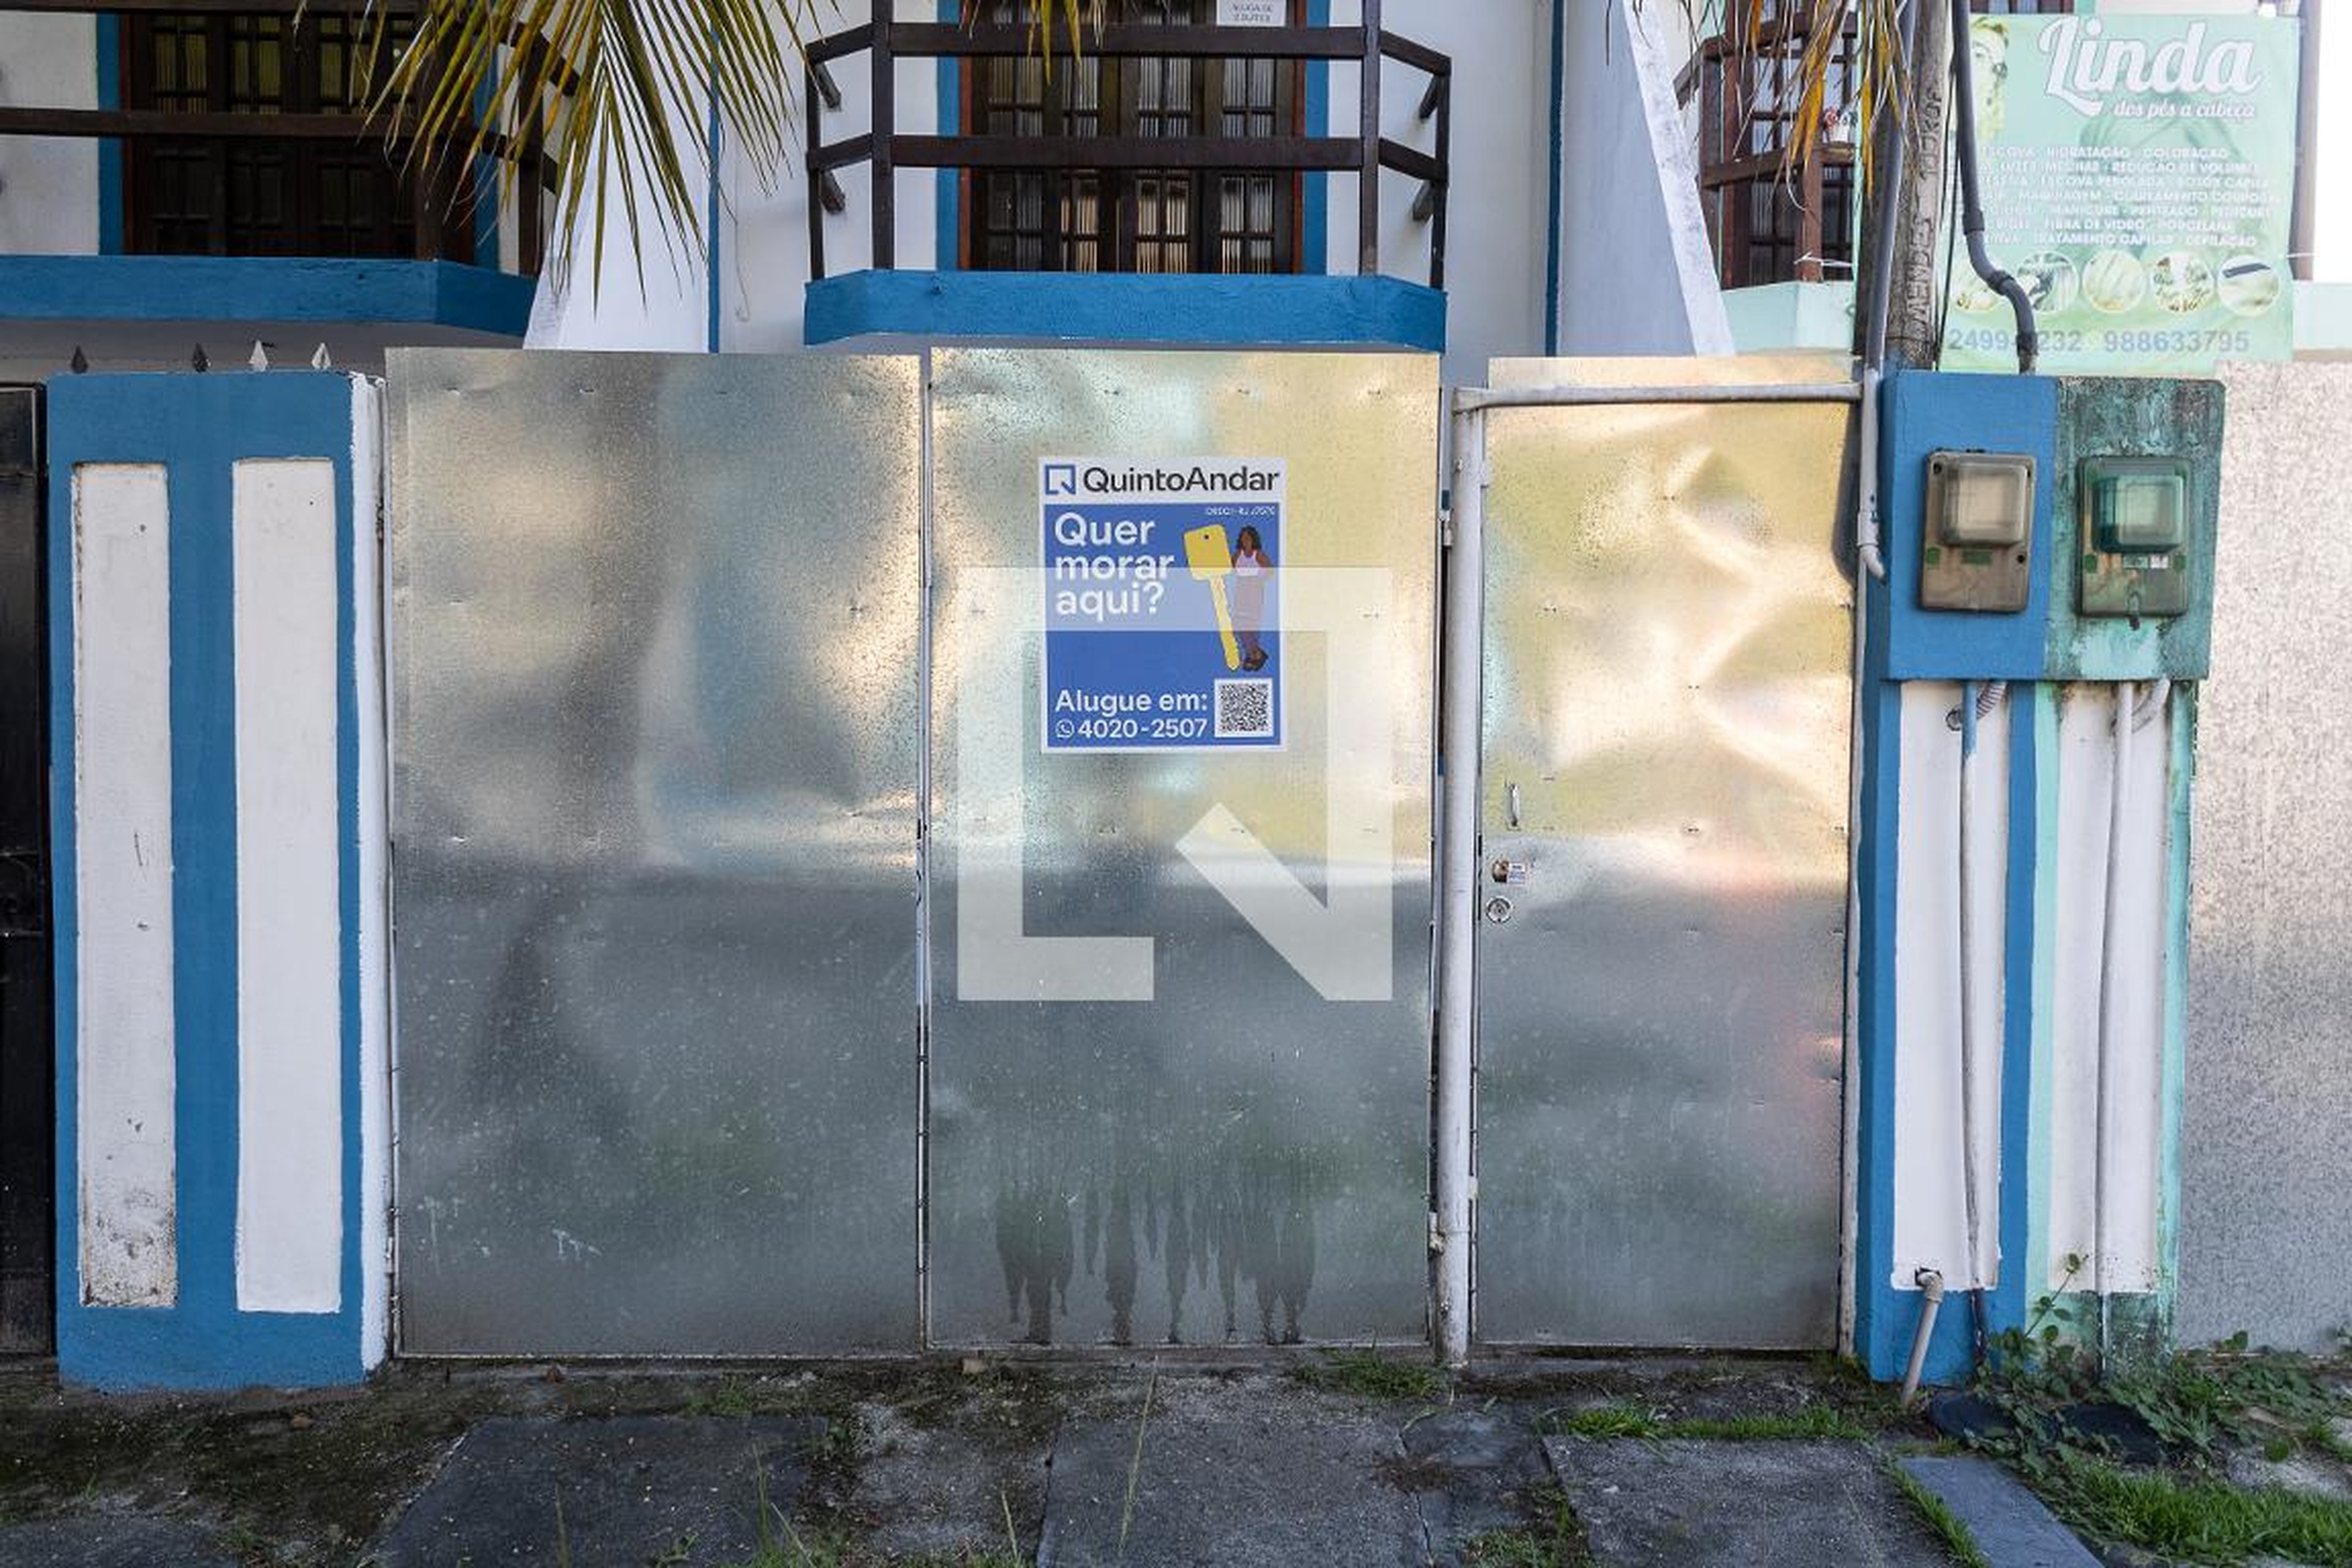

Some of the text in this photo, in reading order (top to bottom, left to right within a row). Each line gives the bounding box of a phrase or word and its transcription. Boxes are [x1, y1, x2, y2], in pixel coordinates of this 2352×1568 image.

[2038, 16, 2264, 116] Linda
[2114, 99, 2255, 121] dos pés a cabeça
[2103, 330, 2249, 353] 988633795
[1083, 466, 1280, 493] QuintoAndar
[1054, 513, 1155, 546] Quer
[1055, 554, 1174, 580] morar
[1056, 583, 1165, 622] aqui?
[1055, 690, 1208, 719] Alugue em:
[1078, 718, 1208, 739] 4020-2507
